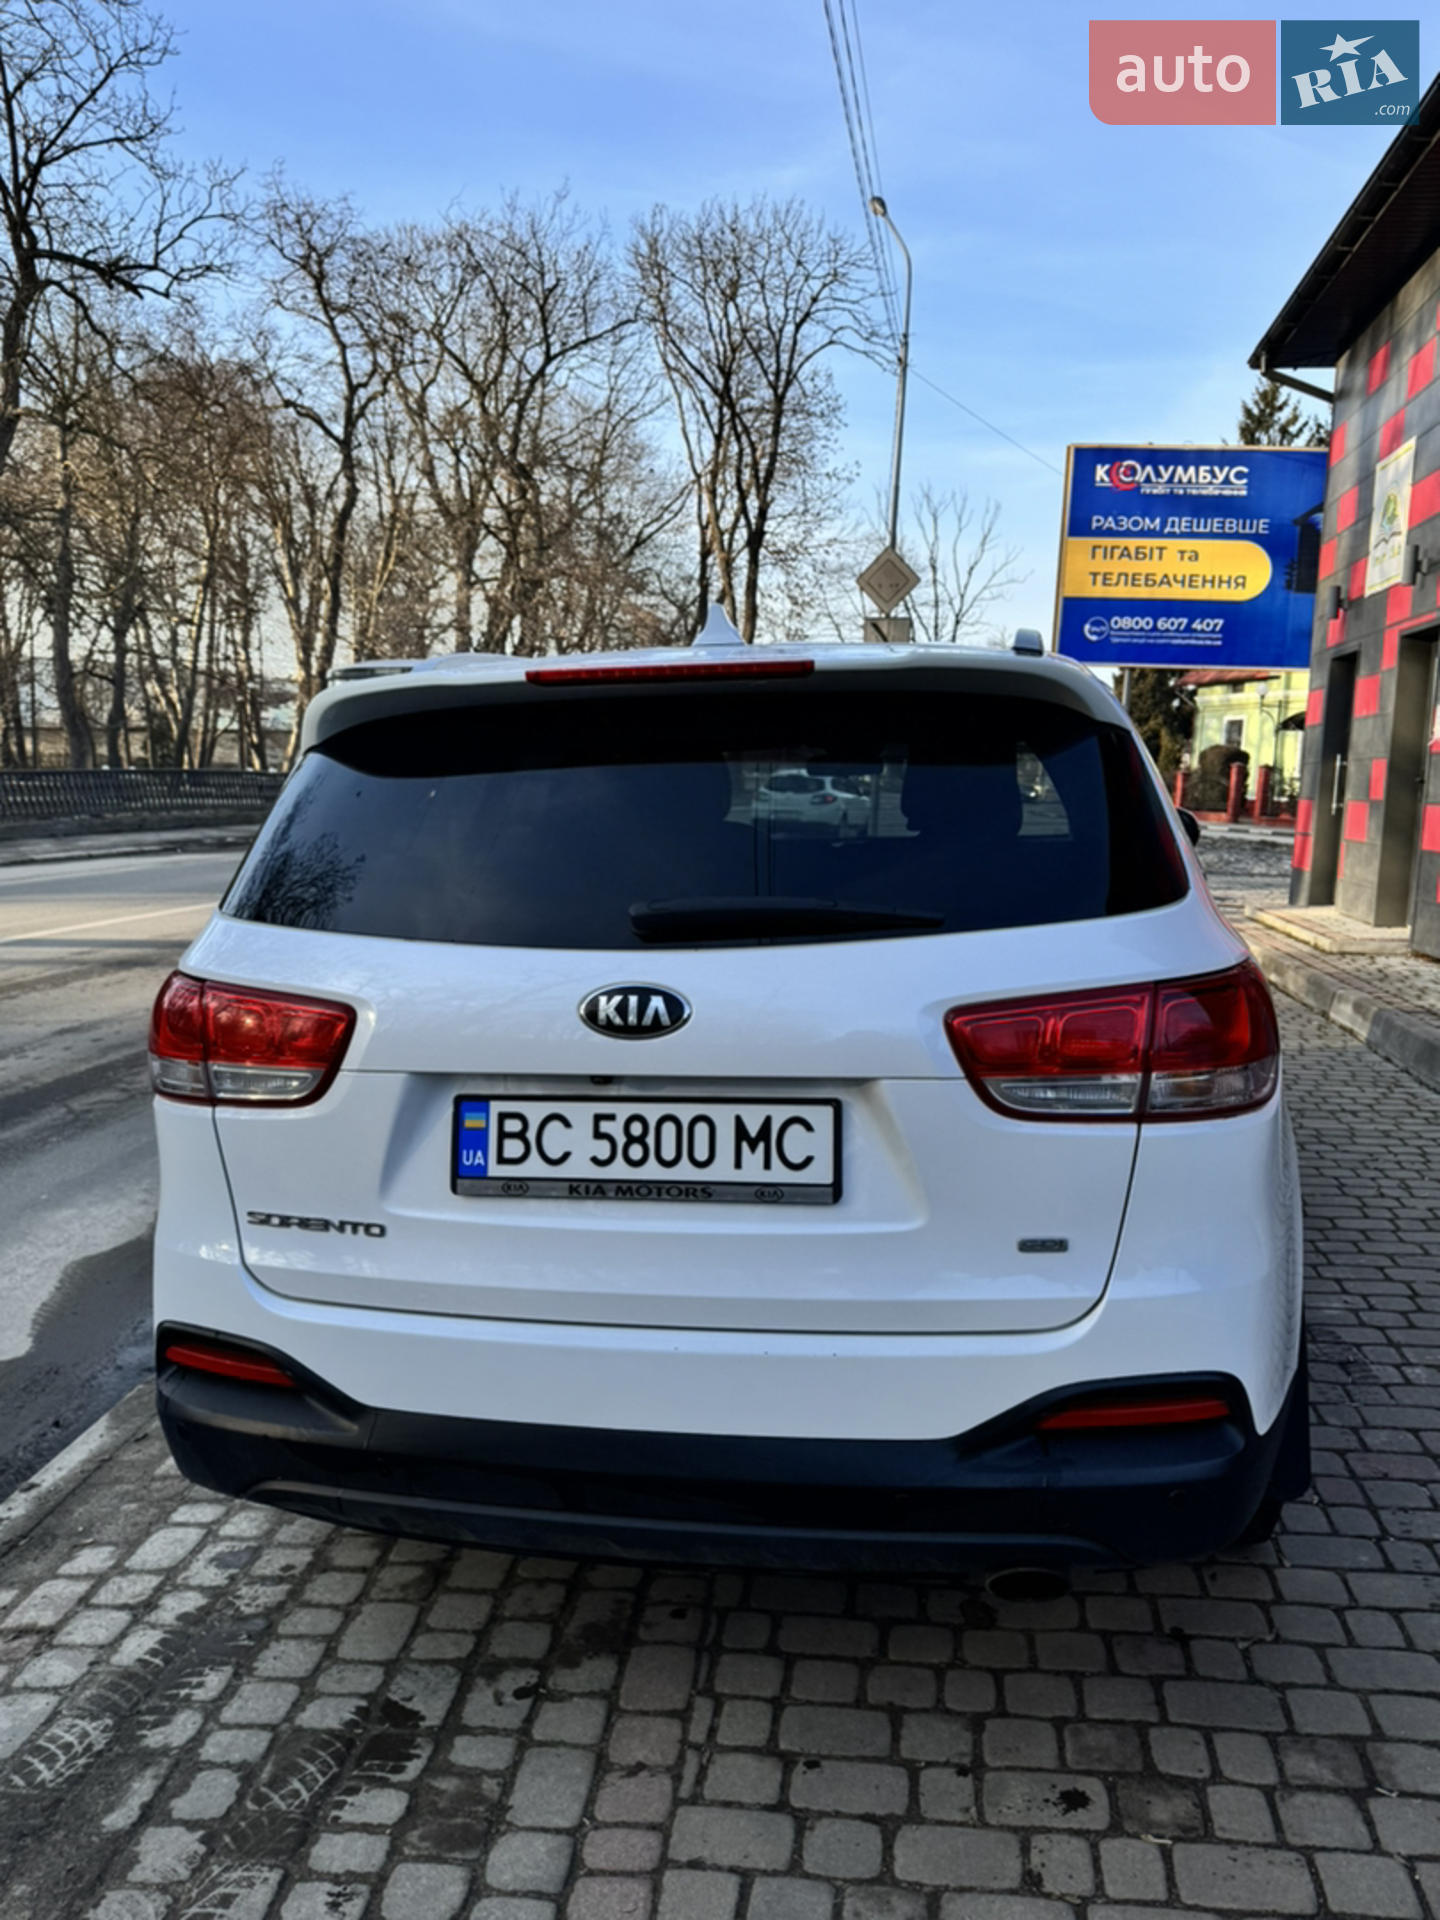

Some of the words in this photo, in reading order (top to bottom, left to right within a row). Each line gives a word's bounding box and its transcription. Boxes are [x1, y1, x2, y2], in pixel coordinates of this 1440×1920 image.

[1095, 460, 1249, 485] КОЛУМБУС
[1090, 515, 1161, 531] РАЗОМ
[1163, 516, 1271, 535] ДЕШЕВШЕ
[1090, 544, 1168, 562] ГІГАБІТ
[1177, 549, 1200, 563] та
[1088, 571, 1247, 590] ТЕЛЕБАЧЕННЯ
[1109, 615, 1154, 630] 0800
[1156, 616, 1189, 631] 607
[1191, 618, 1225, 632] 407
[597, 994, 672, 1027] KIA
[496, 1111, 574, 1167] BC
[589, 1112, 717, 1169] 5800
[734, 1114, 816, 1172] MC
[462, 1148, 486, 1168] UA
[568, 1182, 607, 1197] KIA
[614, 1184, 715, 1200] MOTORS
[246, 1211, 387, 1238] SORENTO
